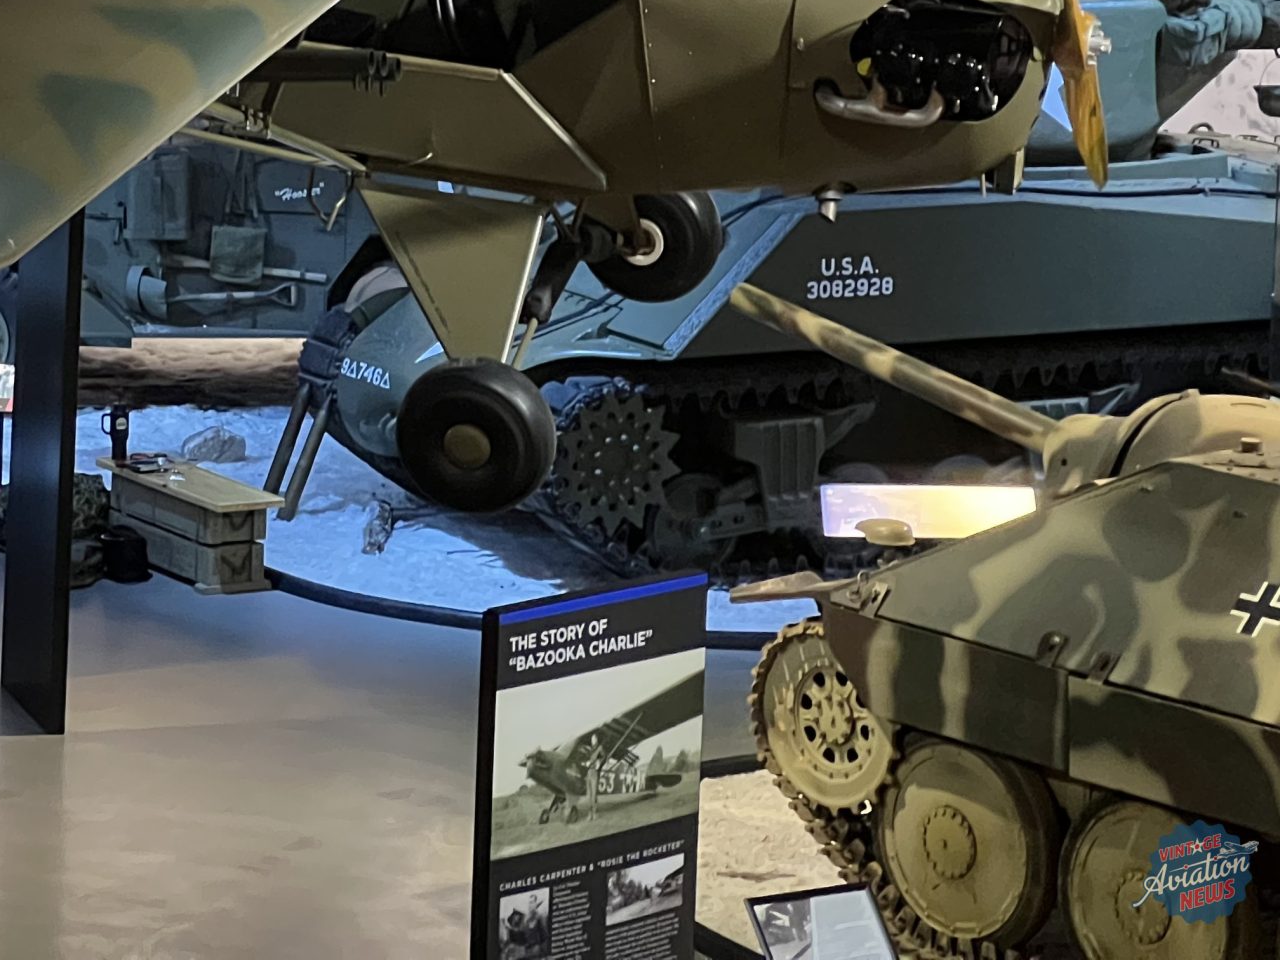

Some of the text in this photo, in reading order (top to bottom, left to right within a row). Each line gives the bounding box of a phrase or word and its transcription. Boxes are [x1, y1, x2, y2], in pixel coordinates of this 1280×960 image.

[821, 255, 879, 277] U.S.A.
[806, 276, 894, 300] 3082928
[509, 618, 608, 653] THE STORY OF
[499, 876, 537, 892] CHARLES
[540, 865, 587, 883] CARPENTER
[626, 850, 641, 862] THE
